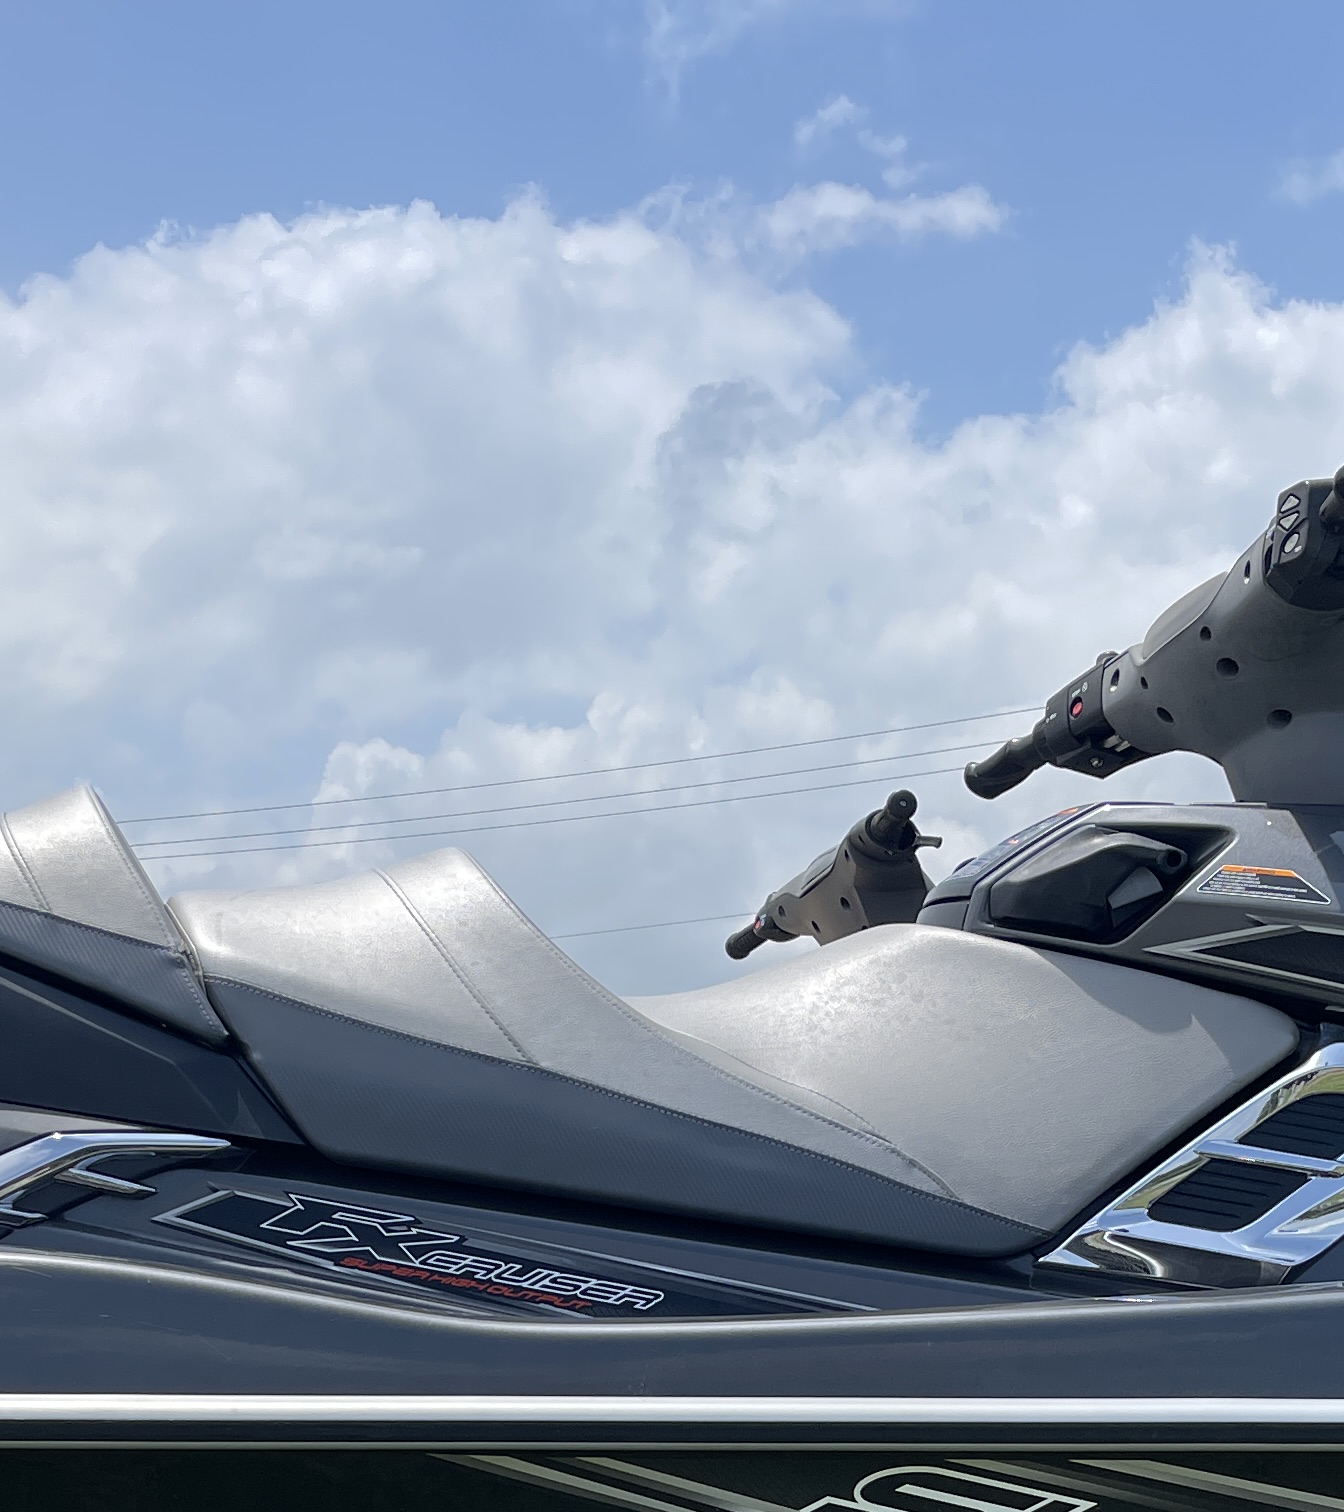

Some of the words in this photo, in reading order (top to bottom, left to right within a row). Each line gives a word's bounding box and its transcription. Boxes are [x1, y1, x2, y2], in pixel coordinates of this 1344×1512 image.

[260, 1193, 461, 1267] FX
[416, 1250, 664, 1311] CRUISER
[340, 1257, 431, 1280] SUPER
[427, 1273, 493, 1292] HIGH
[486, 1284, 593, 1309] OUTPUT
